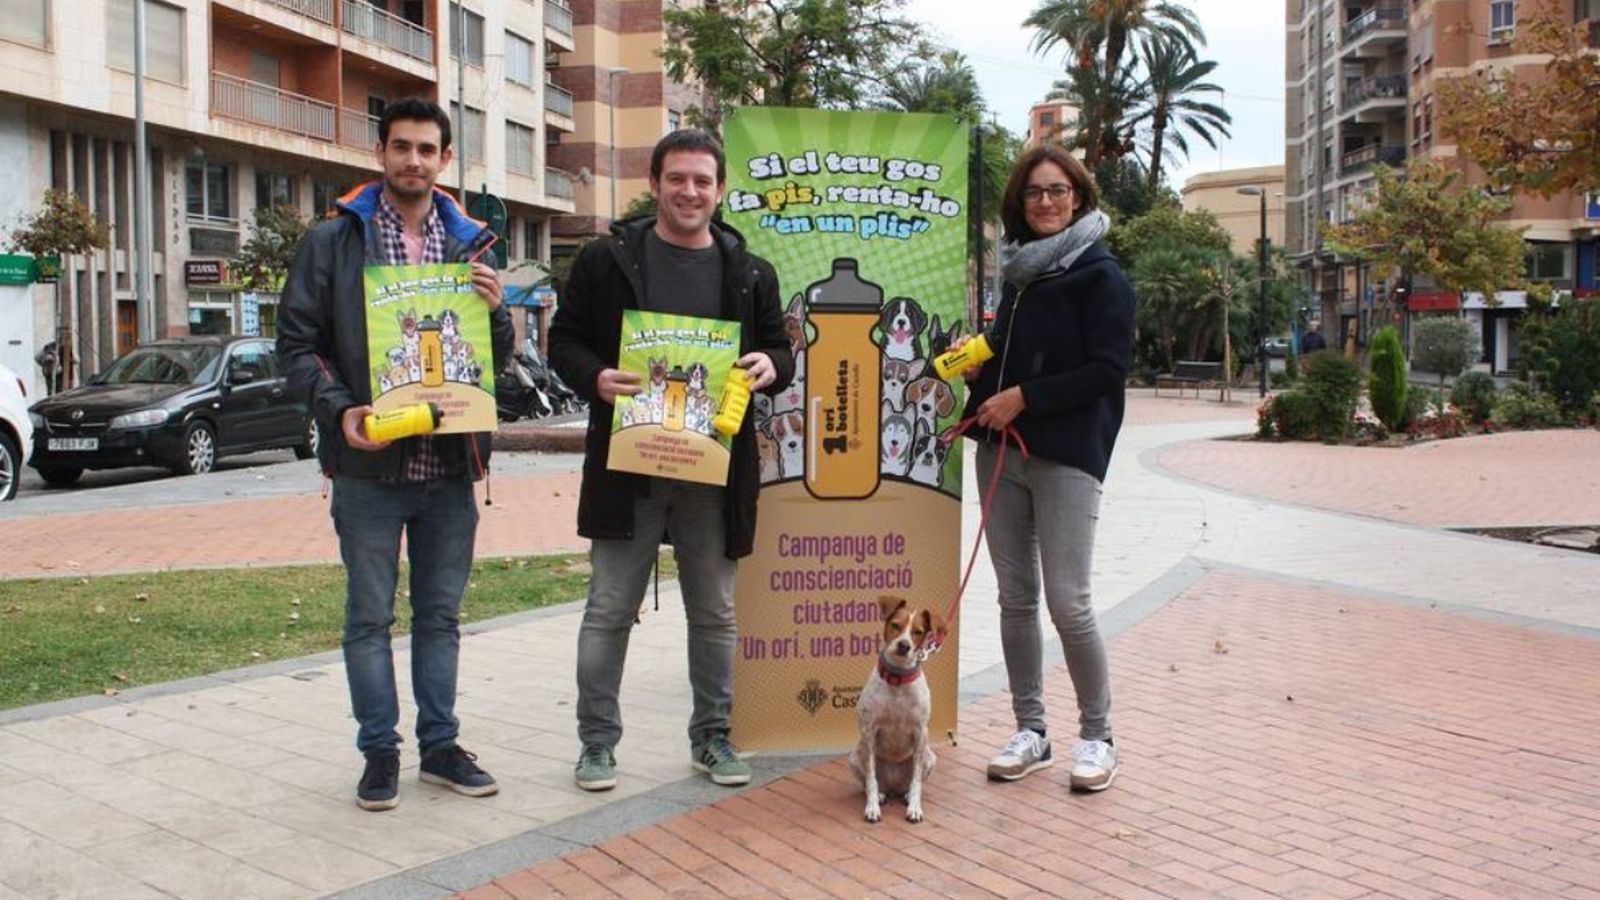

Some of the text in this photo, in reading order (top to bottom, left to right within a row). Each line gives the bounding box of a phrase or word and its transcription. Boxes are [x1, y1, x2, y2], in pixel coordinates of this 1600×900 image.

[749, 151, 941, 181] Si el teu gos
[827, 185, 960, 217] renta-ho
[816, 215, 855, 233] un
[836, 360, 848, 432] botelleta
[823, 435, 848, 455] 1
[778, 532, 905, 563] Campanya de
[770, 561, 913, 591] conscienciació
[811, 636, 844, 658] una
